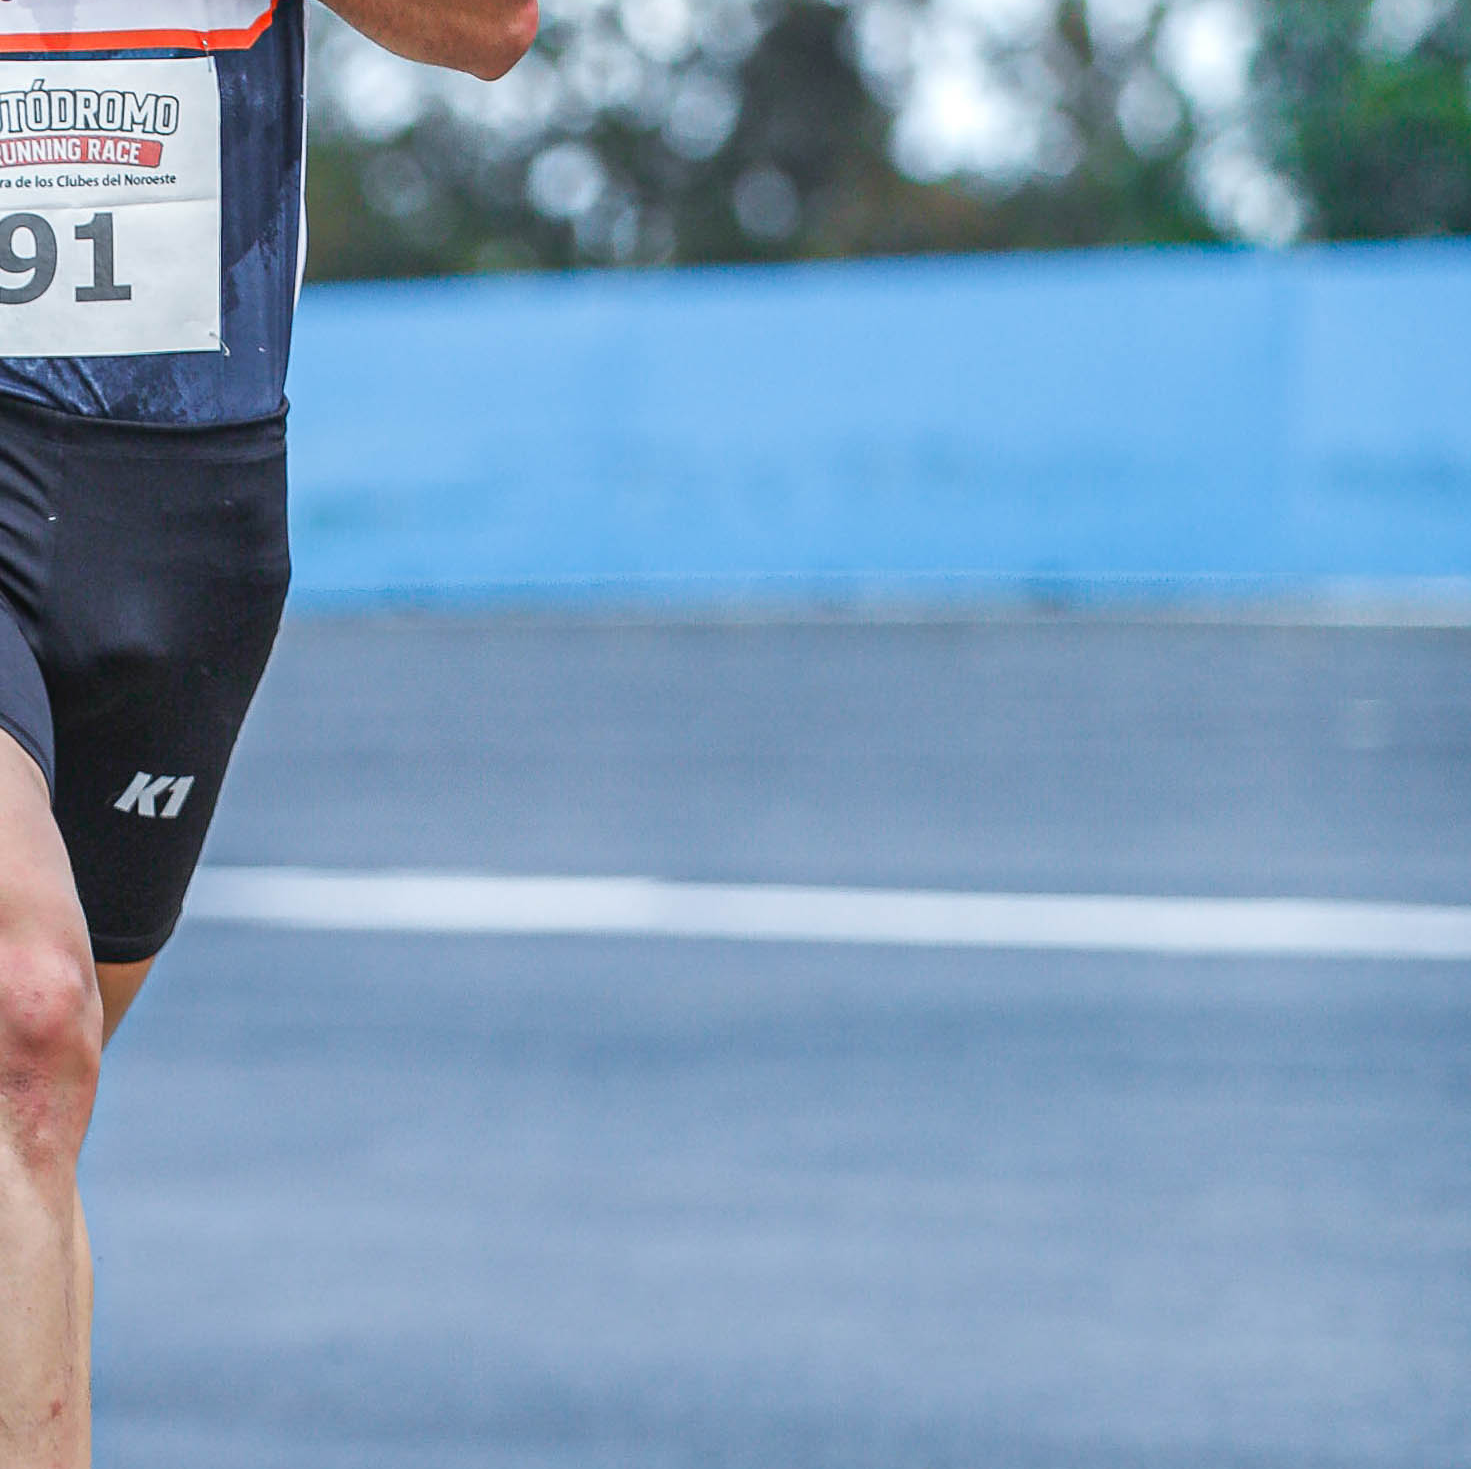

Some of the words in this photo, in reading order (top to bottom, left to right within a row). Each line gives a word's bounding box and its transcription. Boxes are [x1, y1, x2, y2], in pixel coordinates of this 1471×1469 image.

[86, 138, 142, 165] RACE
[15, 175, 32, 188] de
[35, 175, 54, 187] los
[56, 174, 99, 187] Clubes
[102, 173, 121, 186] del
[124, 173, 177, 186] Noroeste
[113, 771, 195, 819] K1
